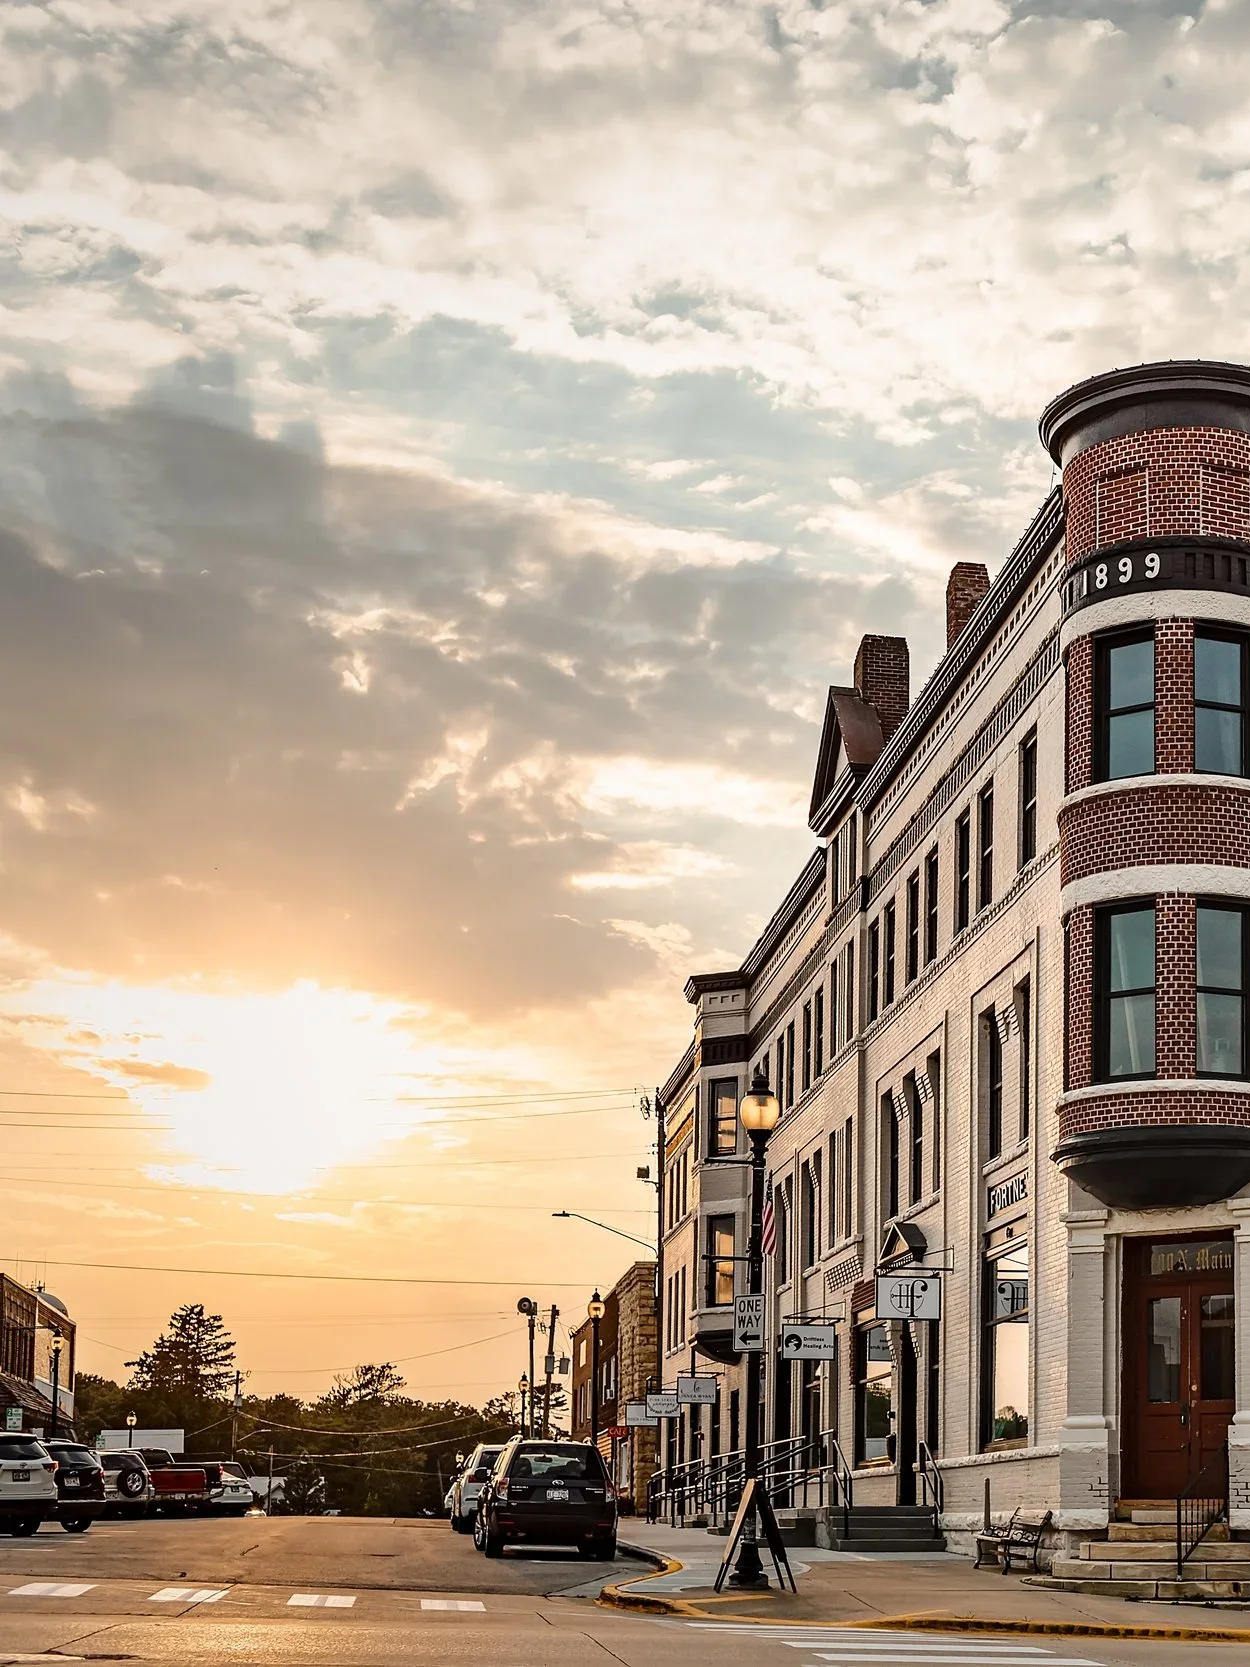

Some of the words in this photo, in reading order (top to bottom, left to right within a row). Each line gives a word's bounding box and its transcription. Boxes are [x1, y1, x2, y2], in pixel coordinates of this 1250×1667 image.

[1080, 553, 1160, 599] 1899
[990, 1174, 1028, 1214] FORTNE
[1196, 1248, 1232, 1270] Main
[738, 1300, 761, 1313] ONE
[738, 1315, 761, 1329] WAY
